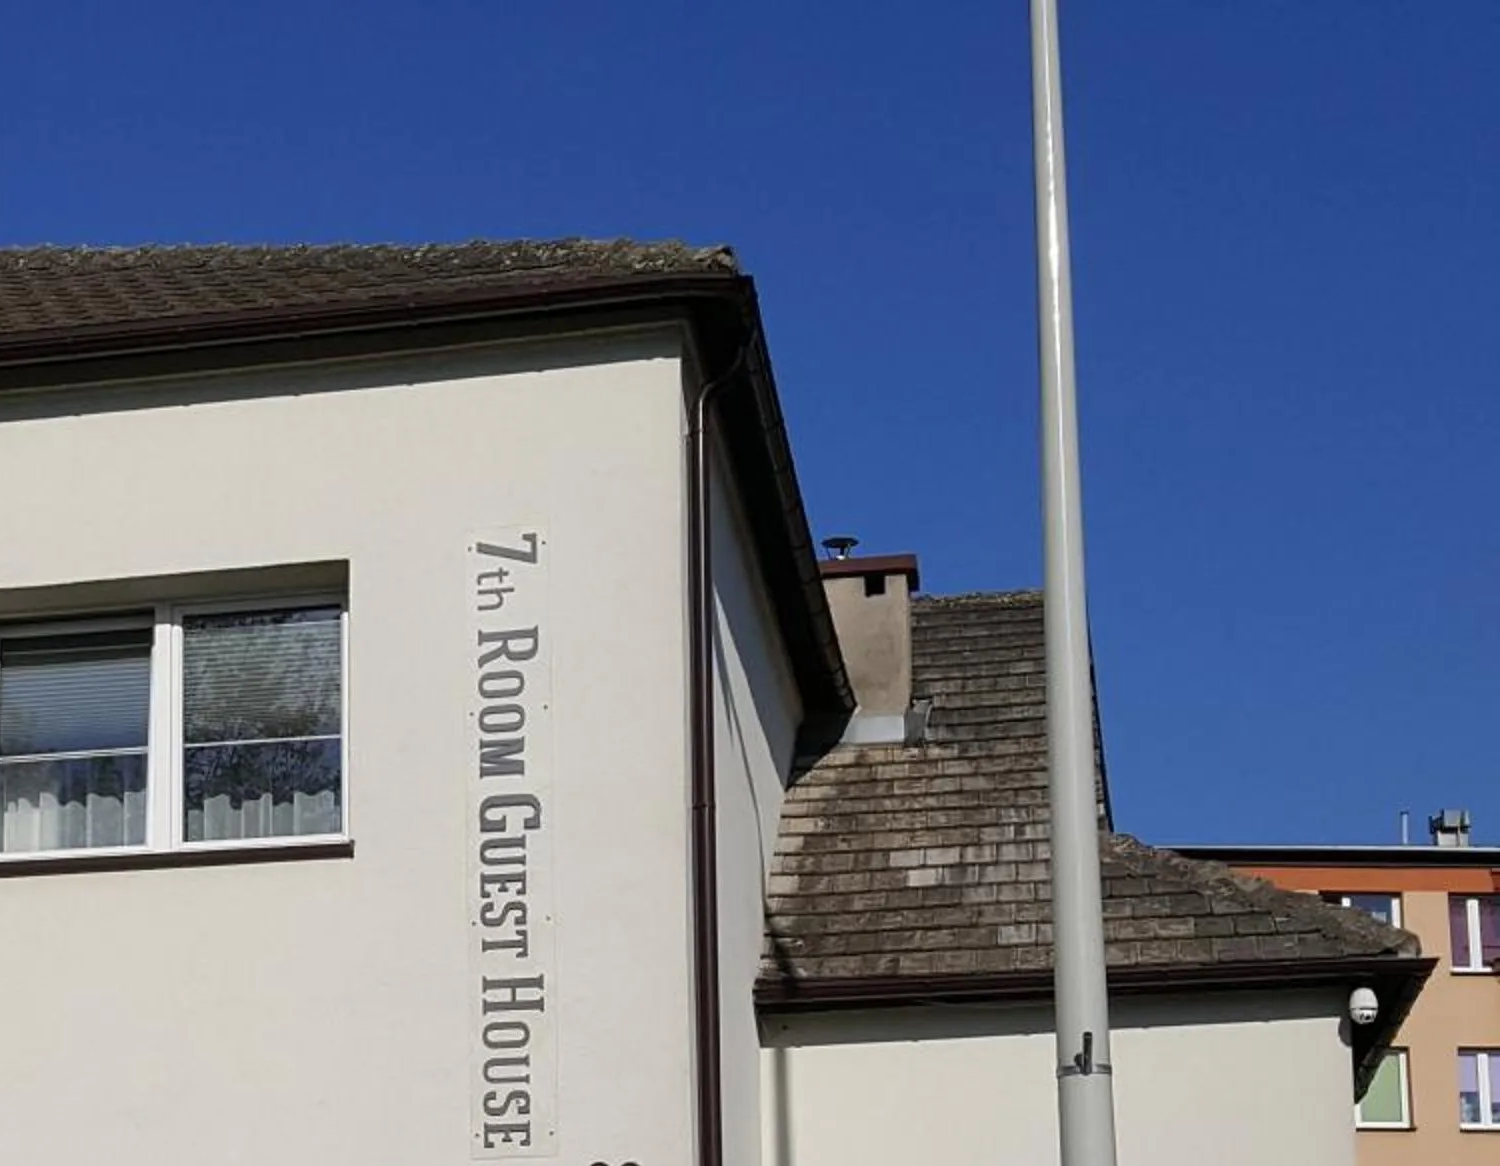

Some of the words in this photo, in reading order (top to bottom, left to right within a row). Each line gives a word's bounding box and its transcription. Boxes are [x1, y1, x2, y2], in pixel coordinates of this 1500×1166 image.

[476, 532, 538, 611] 7th
[477, 625, 539, 779] ROOM
[478, 794, 542, 958] GUEST
[481, 973, 545, 1149] HOUSE
